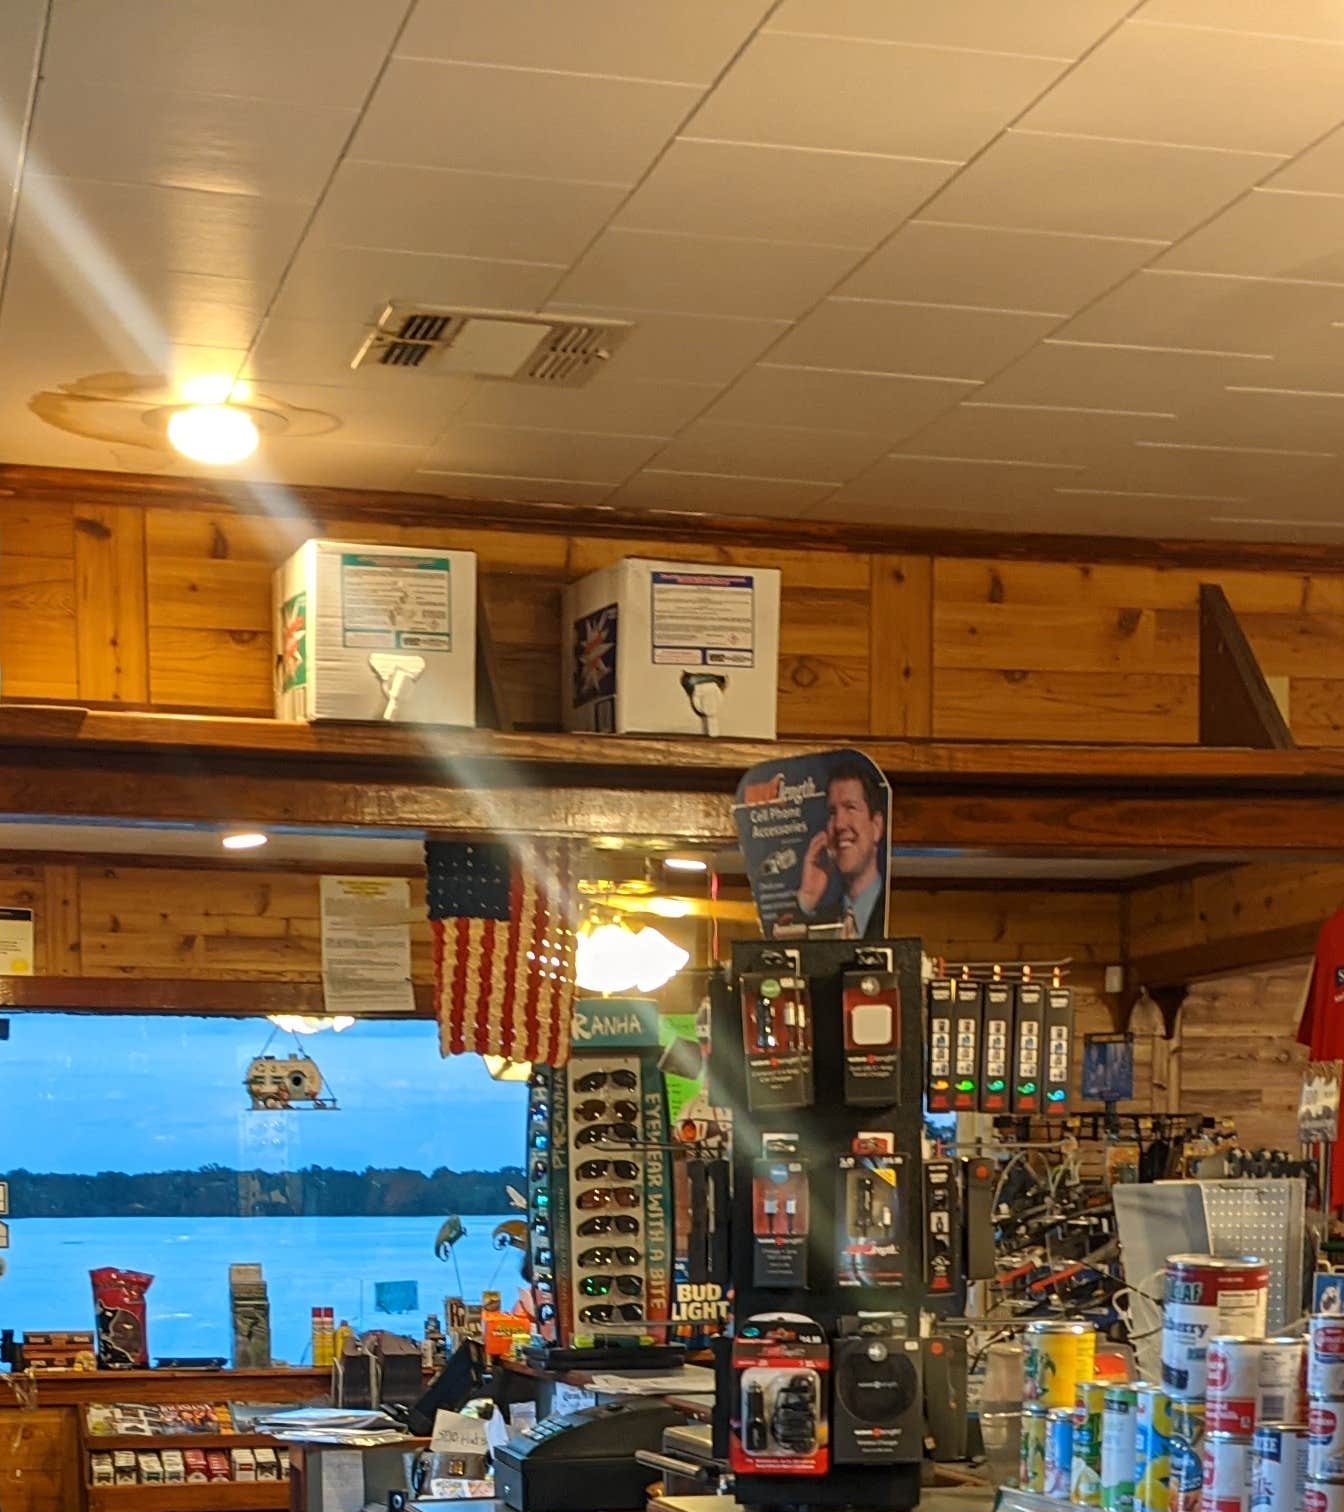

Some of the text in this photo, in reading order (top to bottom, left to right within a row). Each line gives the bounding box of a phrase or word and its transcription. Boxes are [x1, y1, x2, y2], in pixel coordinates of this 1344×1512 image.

[647, 1193, 664, 1242] WITH
[649, 1267, 667, 1311] BITE
[676, 1283, 723, 1305] BUD
[670, 1300, 730, 1322] LIGHT
